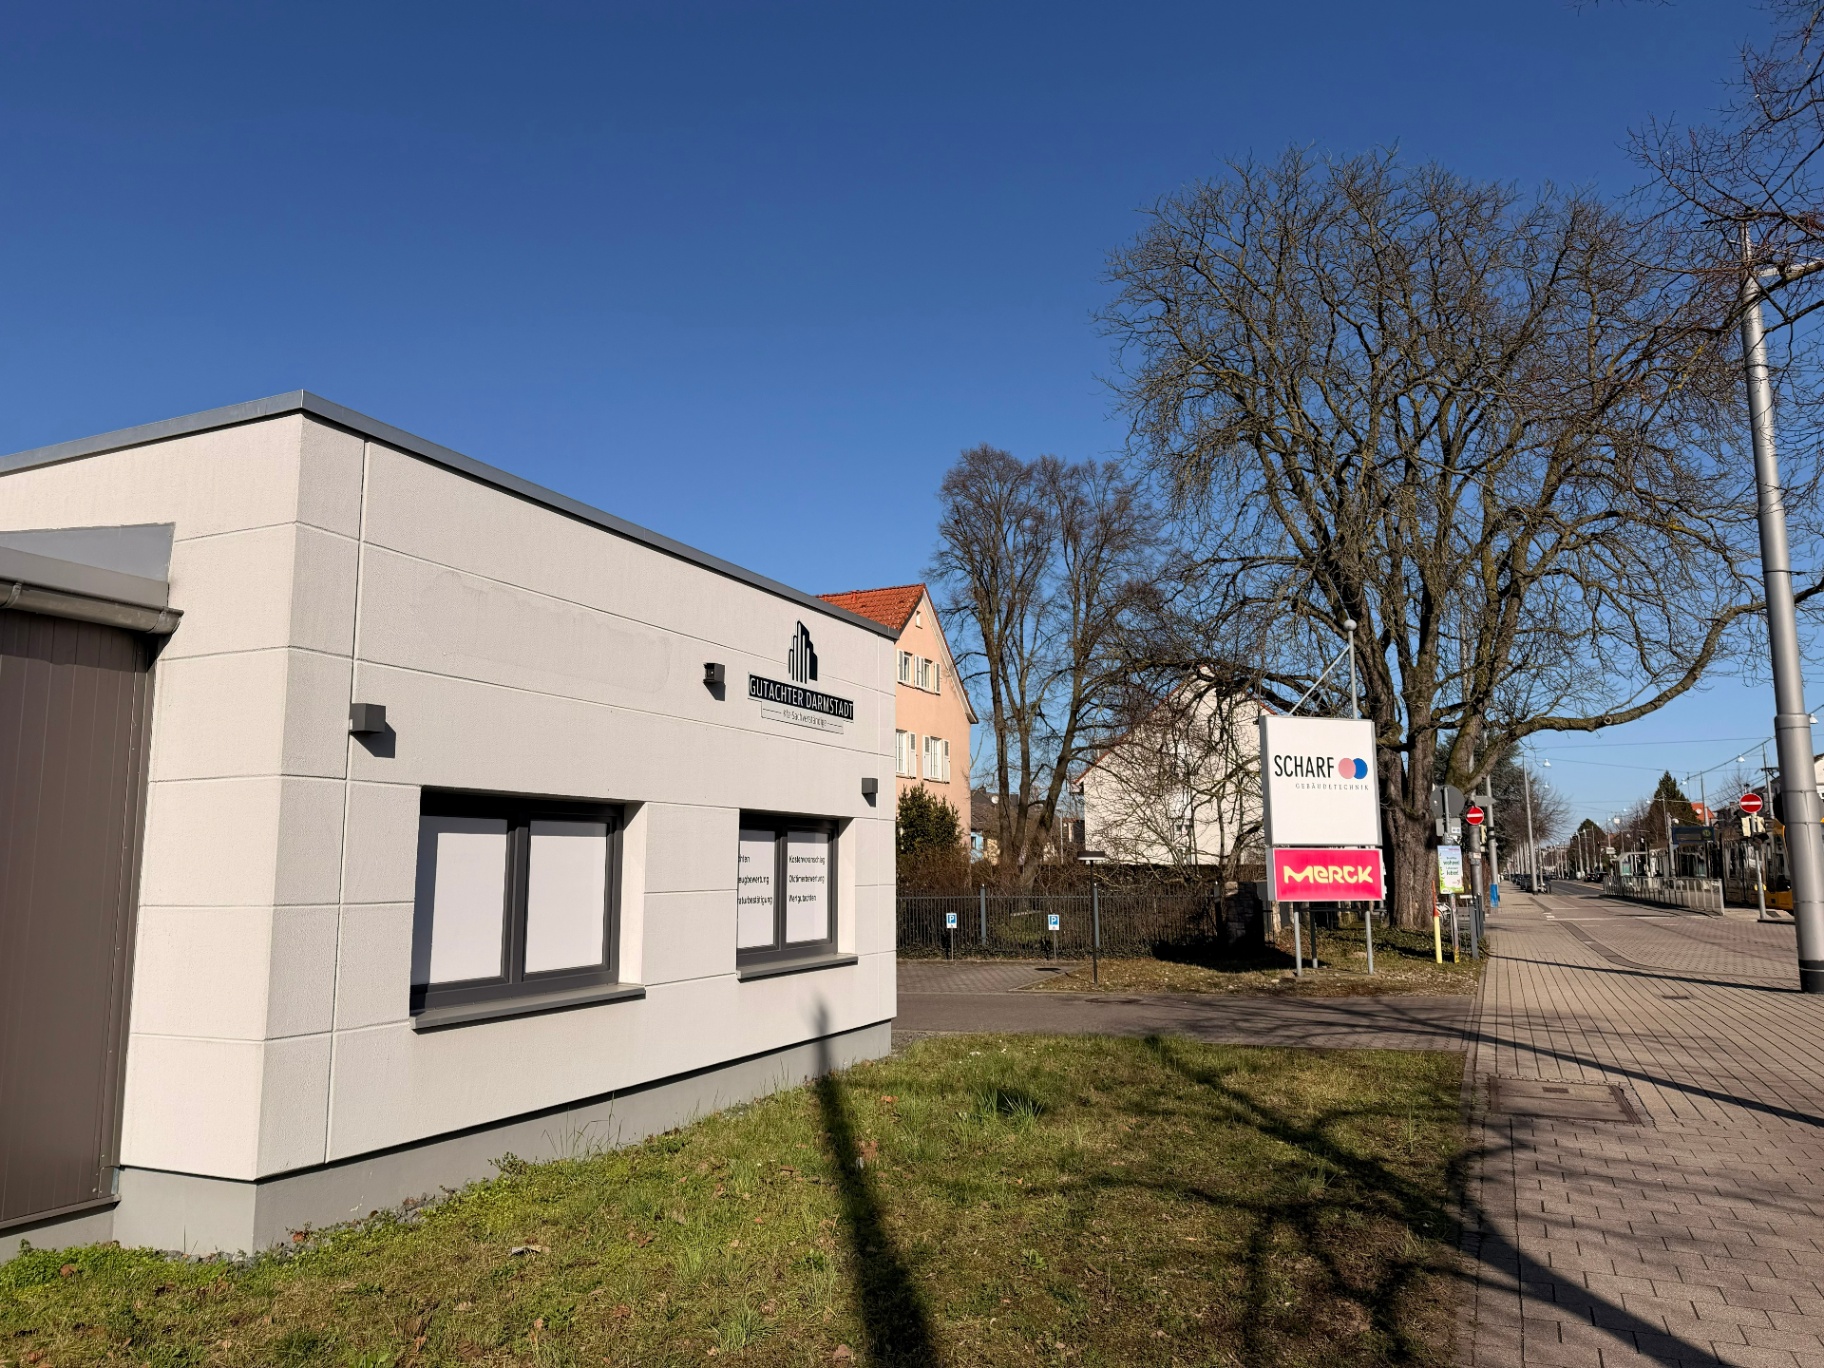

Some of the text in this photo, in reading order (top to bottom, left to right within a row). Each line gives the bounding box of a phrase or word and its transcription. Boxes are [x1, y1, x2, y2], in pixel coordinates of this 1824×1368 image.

[750, 678, 854, 718] GUTACHTER DARMSTADT
[1273, 754, 1335, 778] SCHARF
[1295, 782, 1370, 791] GEBÄUDETECHNIK
[1283, 865, 1374, 884] MERCK
